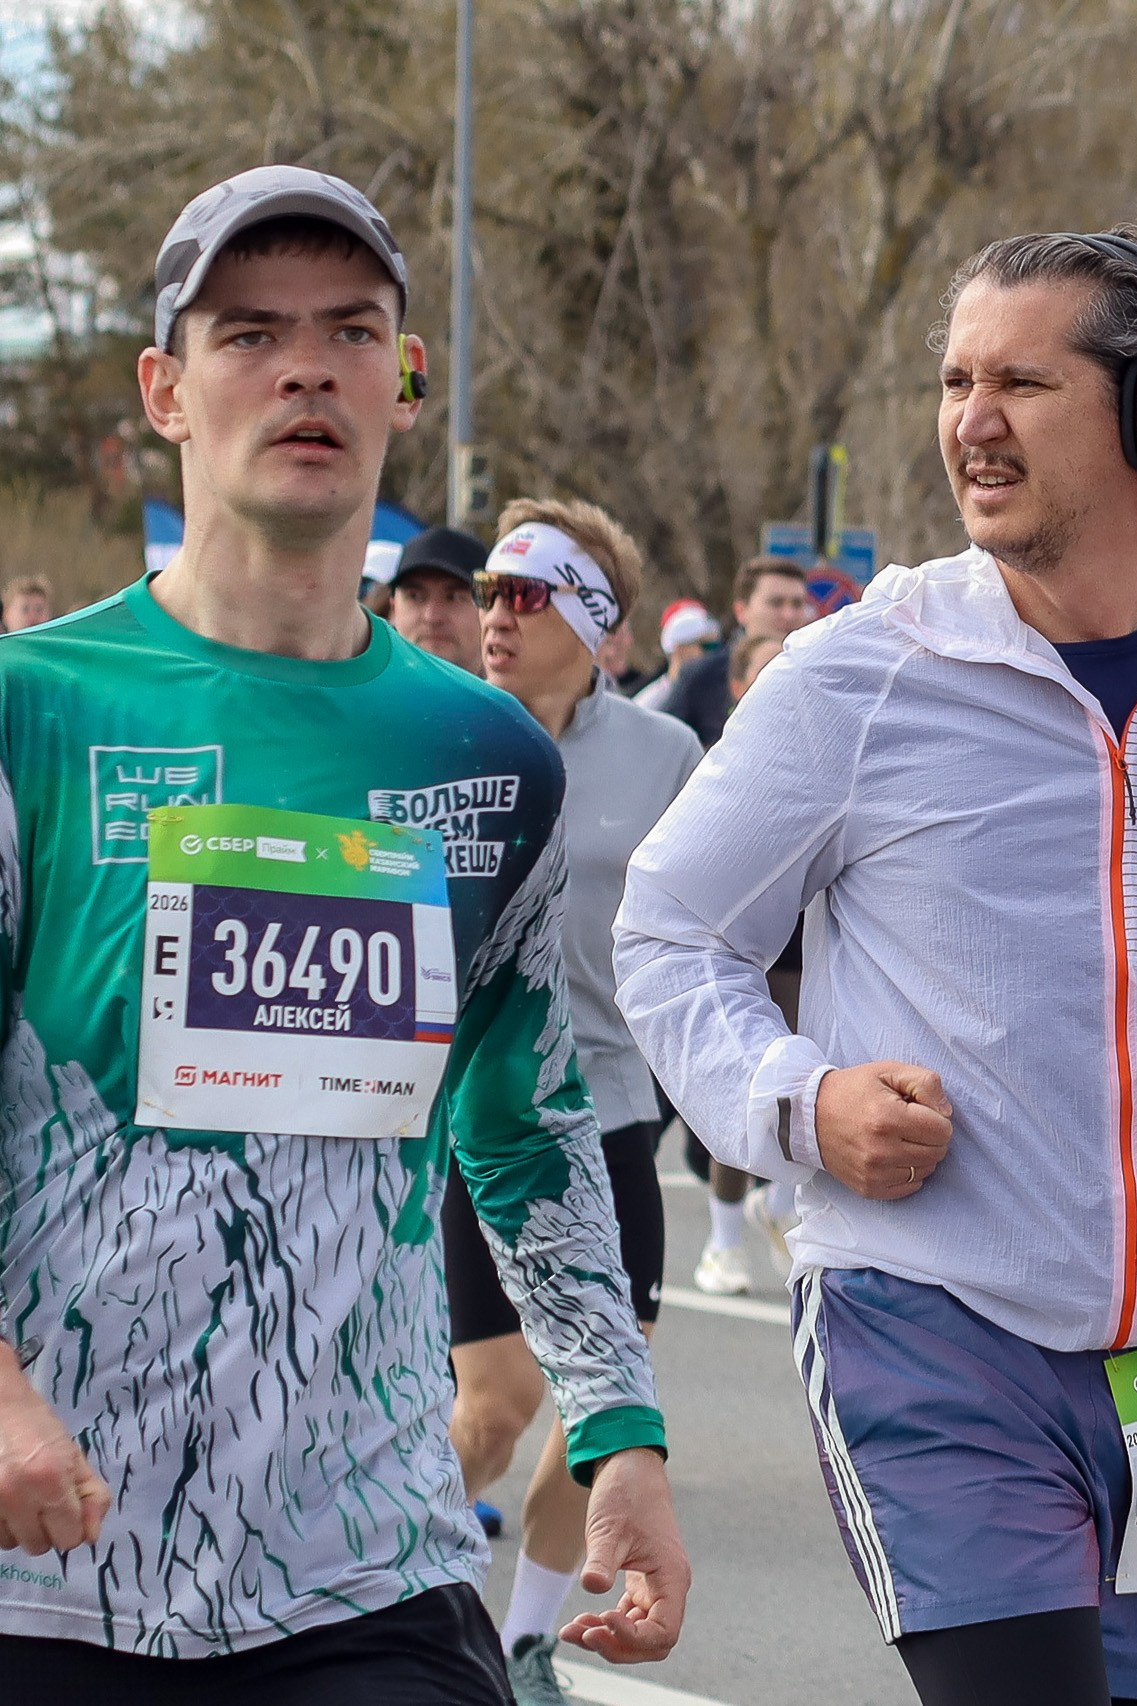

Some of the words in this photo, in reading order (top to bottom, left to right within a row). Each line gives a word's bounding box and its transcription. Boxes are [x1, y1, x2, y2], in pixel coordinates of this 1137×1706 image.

[554, 563, 616, 635] Swix
[116, 765, 199, 785] WE
[378, 778, 516, 824] БОЛЬШЕ
[426, 812, 474, 842] ЕМ
[206, 836, 255, 853] СБЕР
[150, 894, 188, 912] 2026
[211, 918, 401, 1006] 36490
[253, 1003, 351, 1032] АЛЕКСЕЙ
[201, 1069, 283, 1088] МАГНИТ
